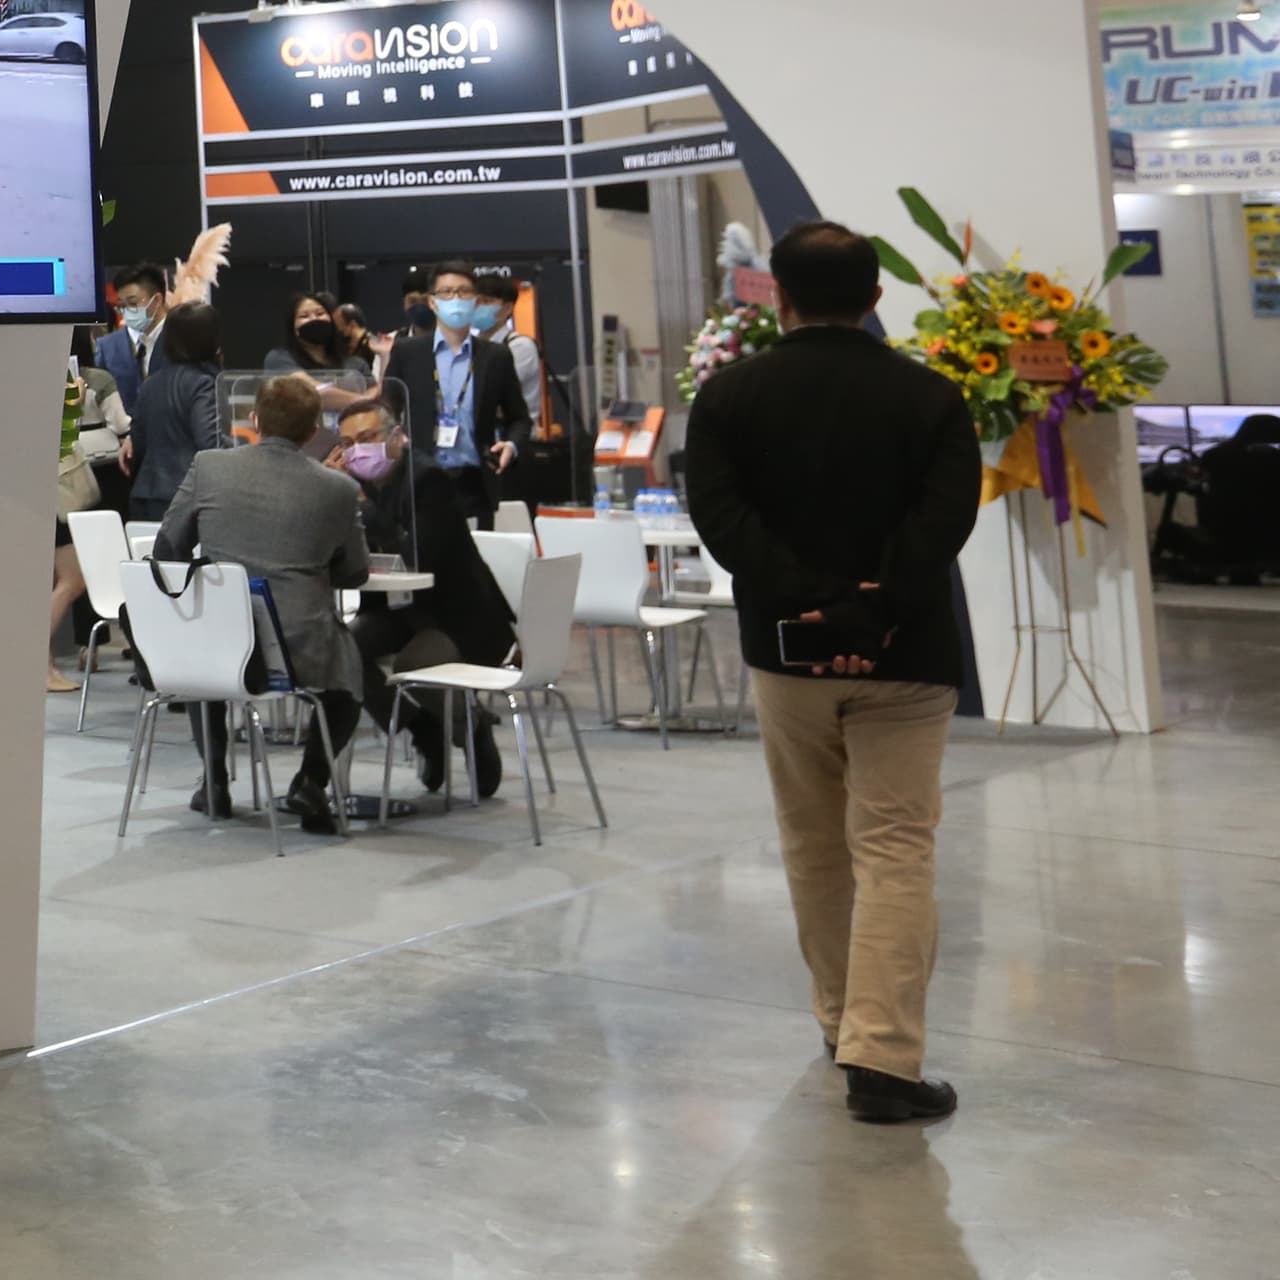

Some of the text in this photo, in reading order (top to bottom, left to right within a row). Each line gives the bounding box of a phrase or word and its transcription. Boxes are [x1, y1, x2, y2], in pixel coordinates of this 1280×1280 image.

[318, 55, 466, 79] Moving Intelligence
[623, 140, 736, 169] www.caravision.com.tw
[290, 165, 501, 191] www.caravision.com.tw
